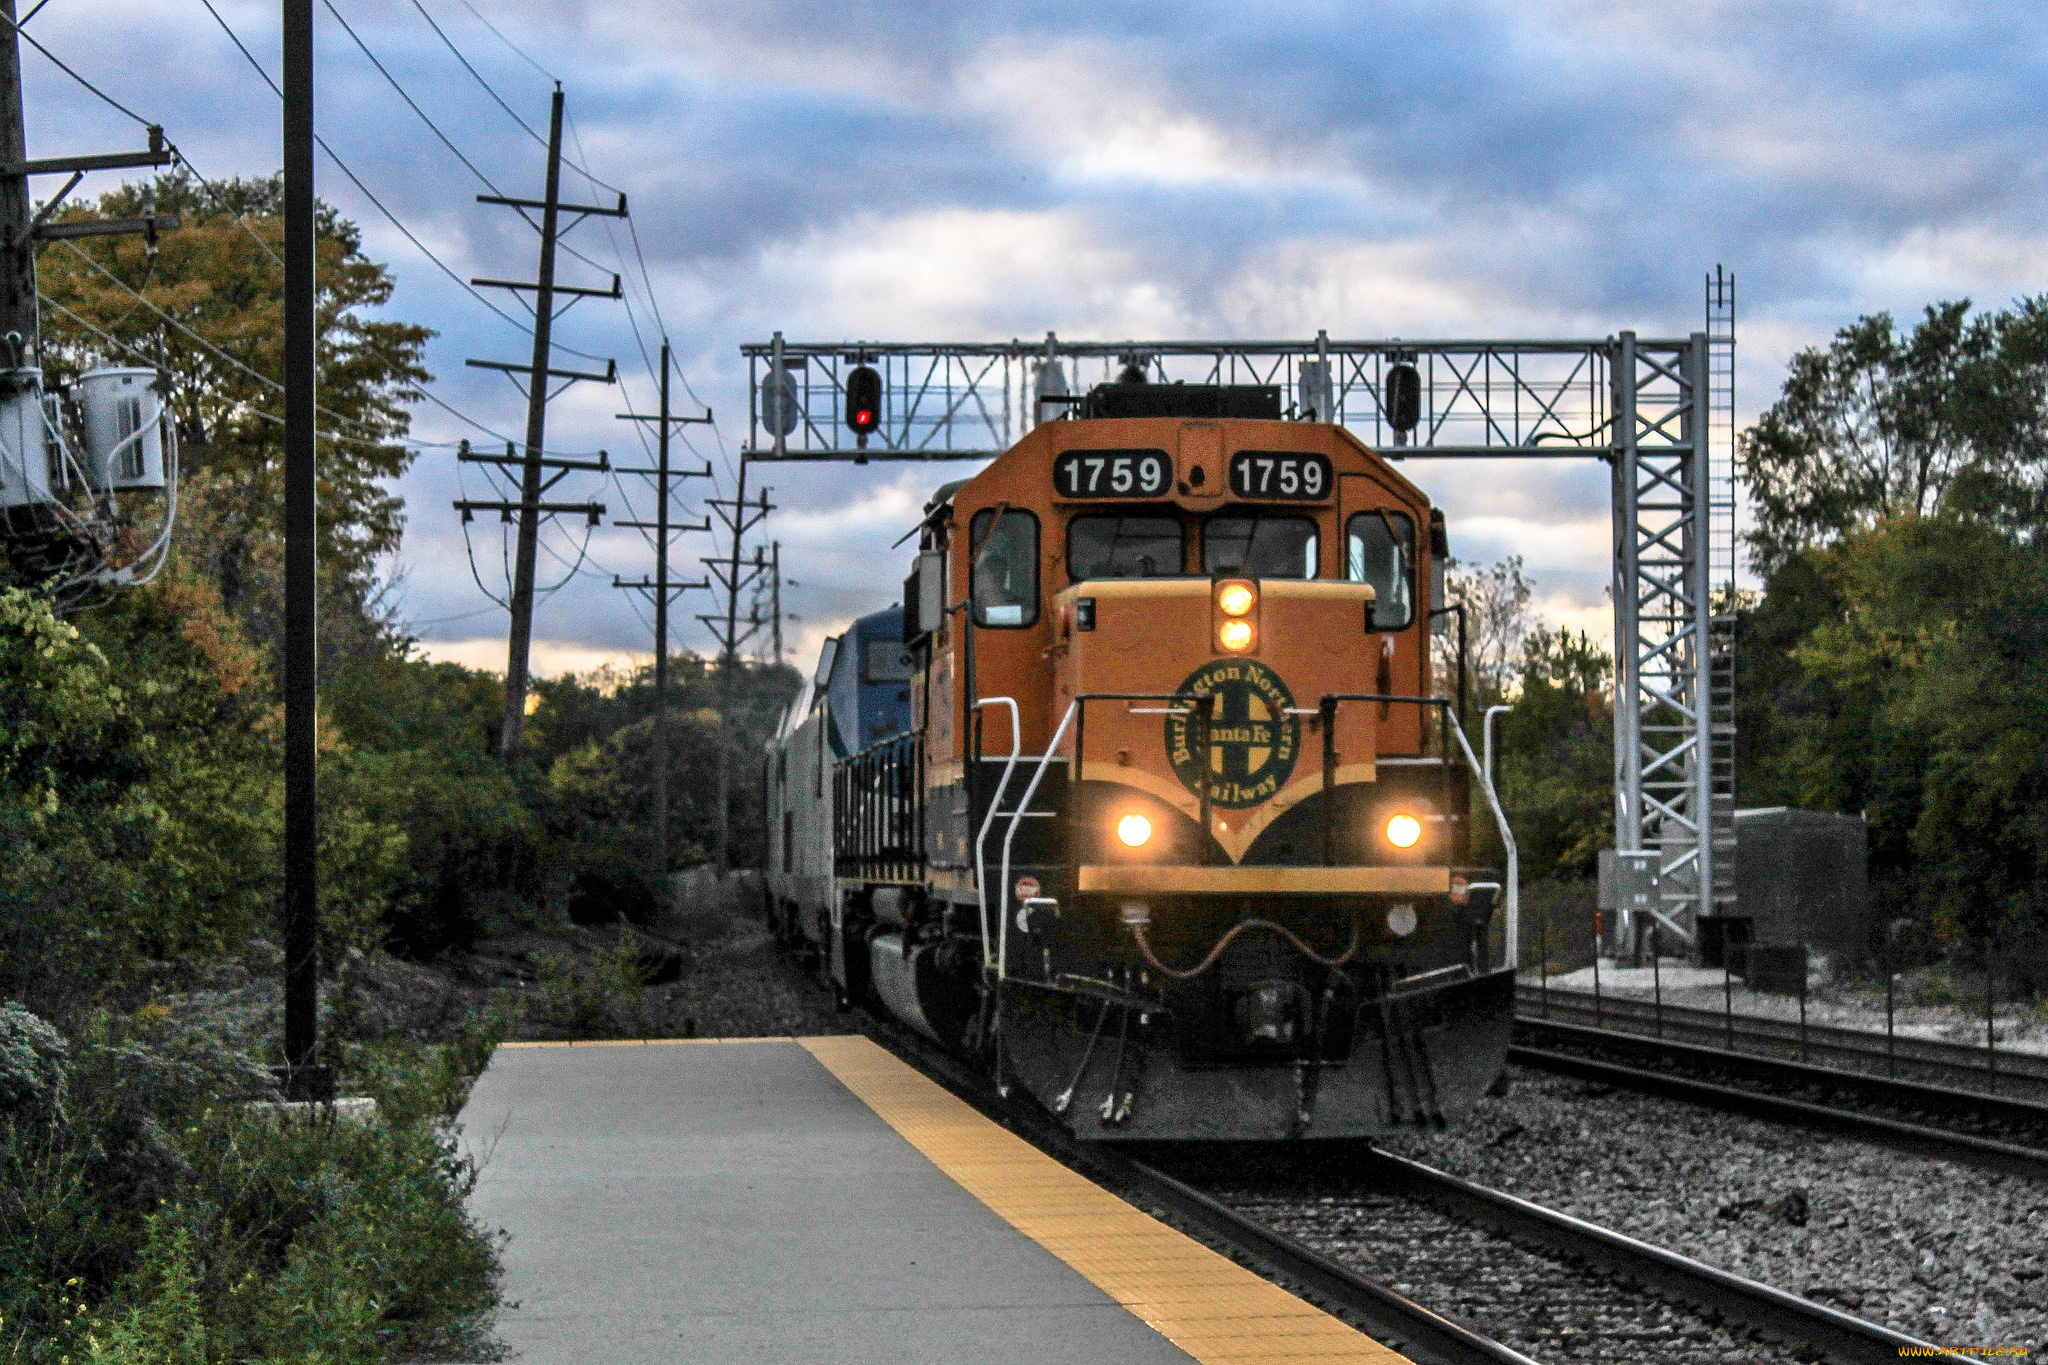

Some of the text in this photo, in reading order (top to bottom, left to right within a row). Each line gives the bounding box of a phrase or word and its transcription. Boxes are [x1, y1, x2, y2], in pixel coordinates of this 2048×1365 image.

[1064, 457, 1161, 492] 1759
[1237, 458, 1322, 495] 1759
[1171, 667, 1240, 766] Burlgton
[1197, 724, 1272, 743] anta Fe
[1195, 773, 1276, 803] ailway
